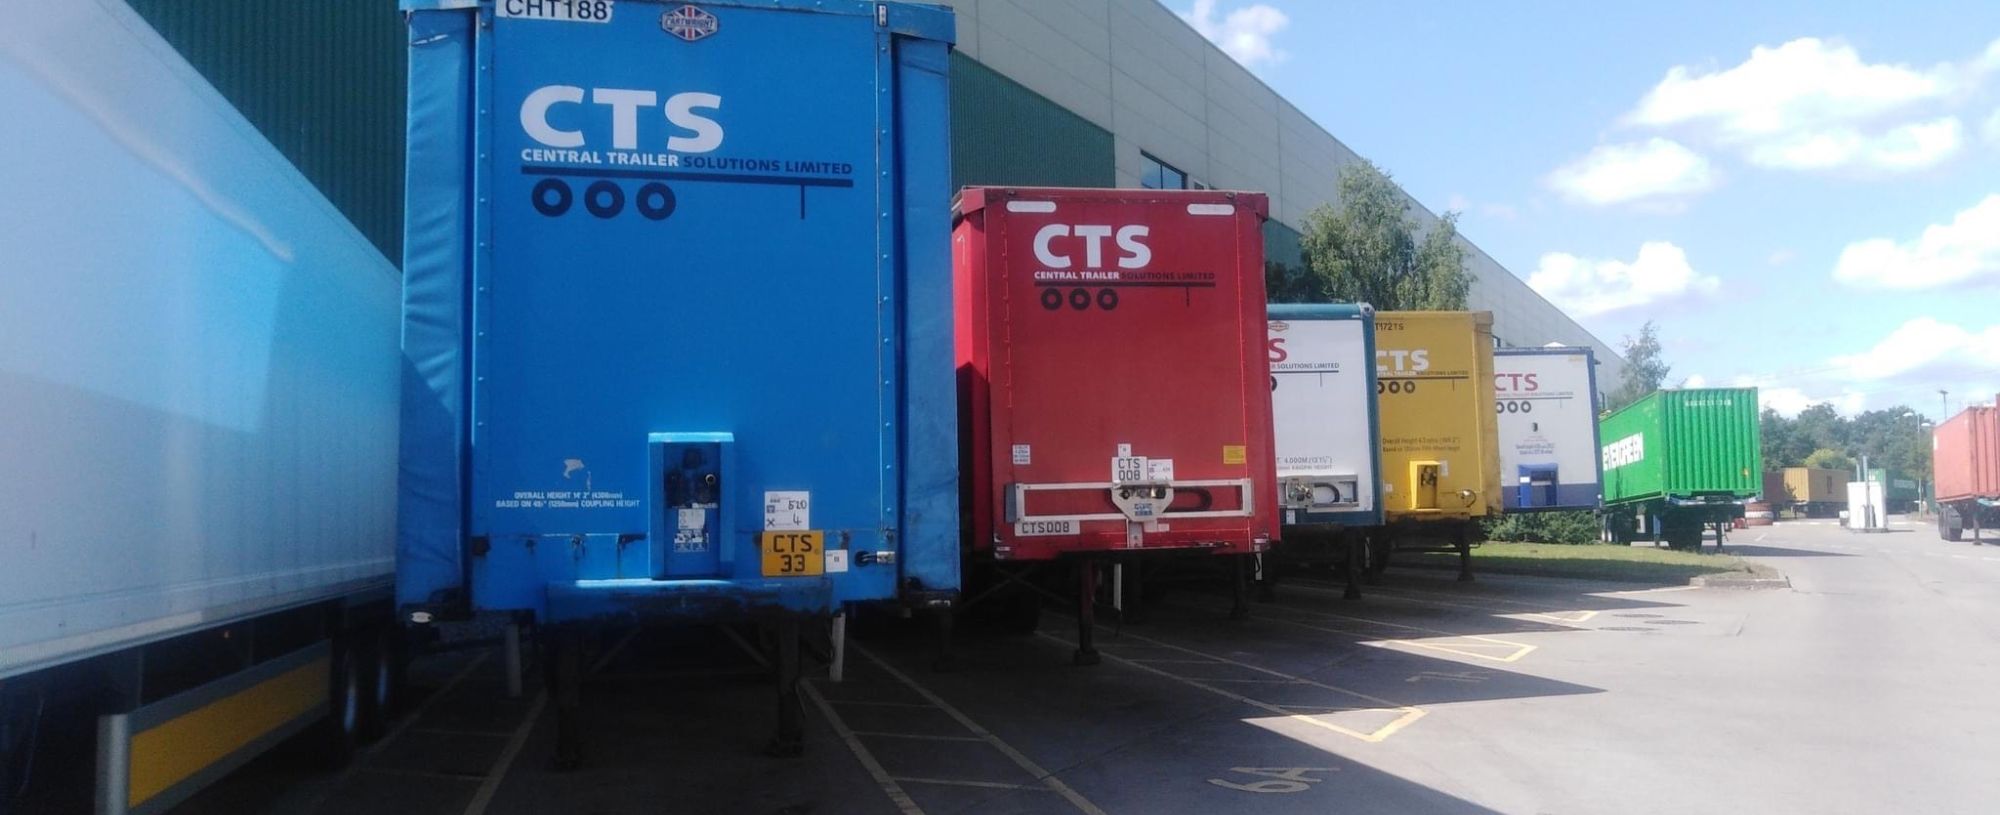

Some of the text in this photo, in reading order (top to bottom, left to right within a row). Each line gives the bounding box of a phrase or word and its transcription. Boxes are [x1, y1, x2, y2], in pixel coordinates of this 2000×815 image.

[505, 0, 608, 20] CHT188
[520, 85, 724, 153] CTS
[521, 149, 853, 175] CENTRAL TRAILER SOLUTIONS LIMITED
[1033, 223, 1152, 269] CTS
[1034, 271, 1216, 280] CENTRAL TRAILER SOLUTIONS LIMITED
[1277, 362, 1313, 370] SOLUTIONS
[1118, 458, 1141, 469] CTS
[1118, 470, 1141, 481] 008
[496, 500, 519, 508] BASED
[520, 500, 531, 508] ON
[580, 500, 615, 508] COUPLING
[792, 512, 803, 526] 4
[1022, 521, 1070, 534] CTS008
[773, 534, 813, 553] CTS
[780, 554, 806, 573] 33
[1207, 766, 1341, 793] 6A
